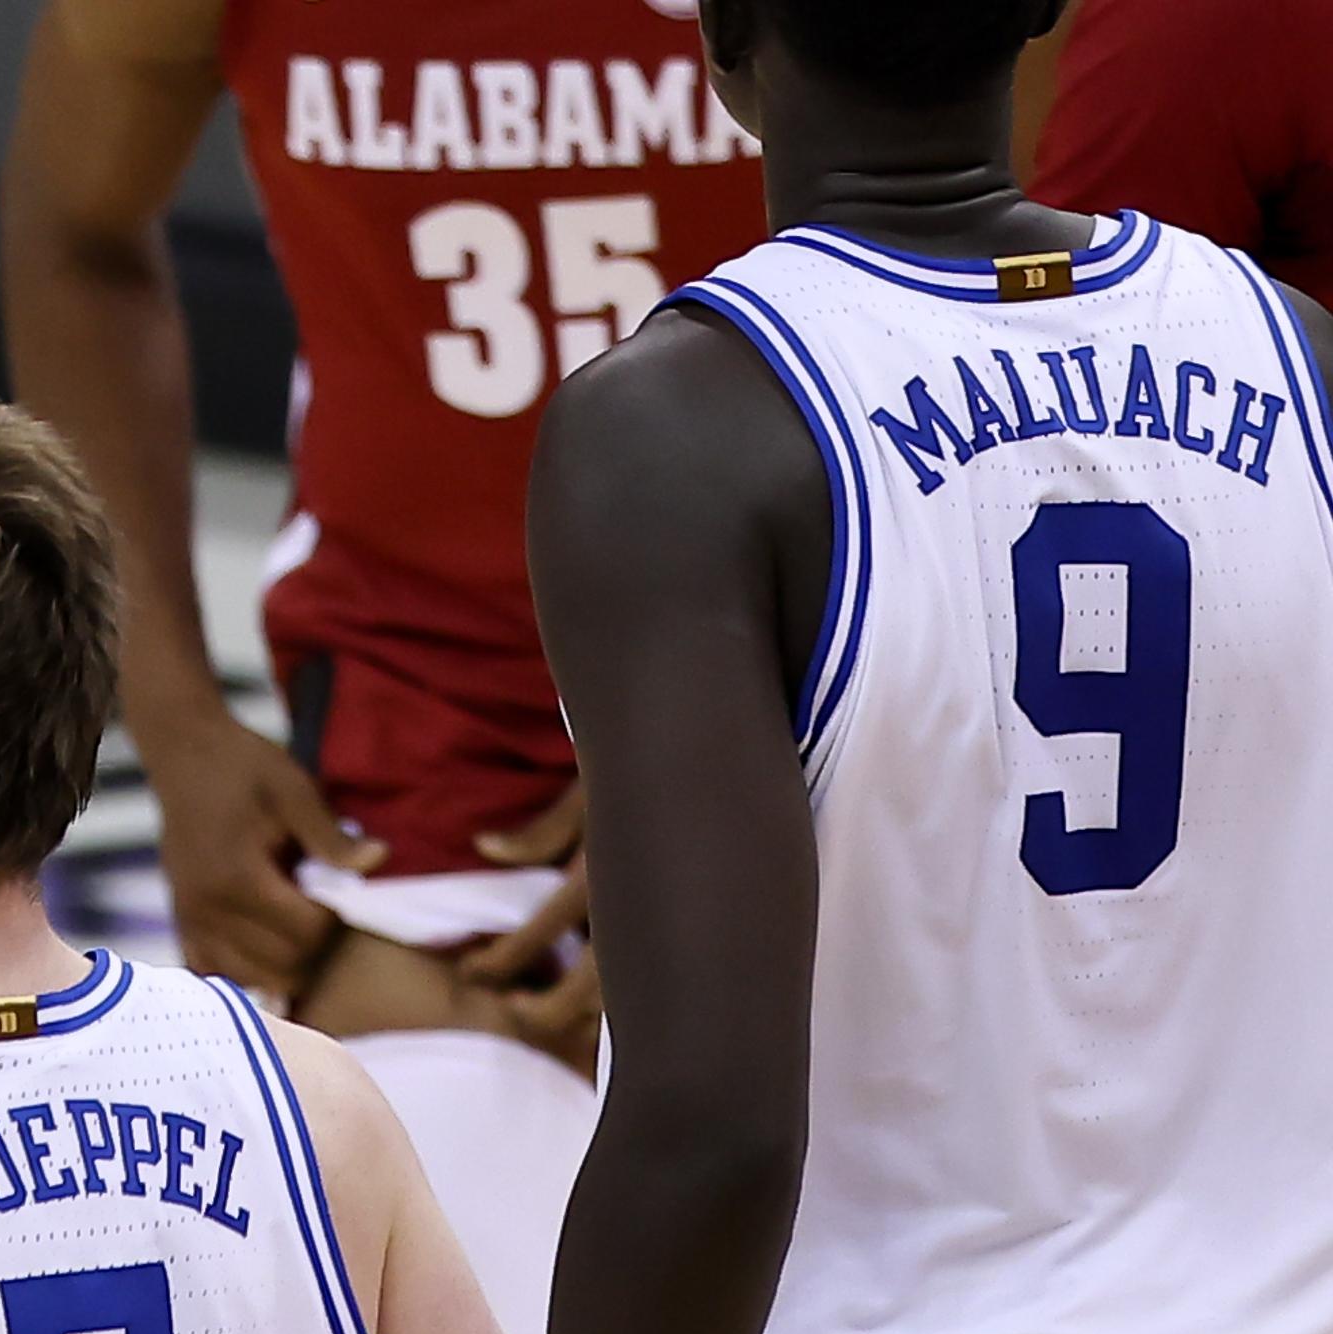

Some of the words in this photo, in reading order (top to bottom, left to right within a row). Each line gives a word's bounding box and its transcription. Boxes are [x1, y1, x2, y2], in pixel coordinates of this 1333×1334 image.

[408, 194, 668, 418] 35
[870, 344, 1286, 496] MALUACH
[1011, 501, 1191, 896] 9
